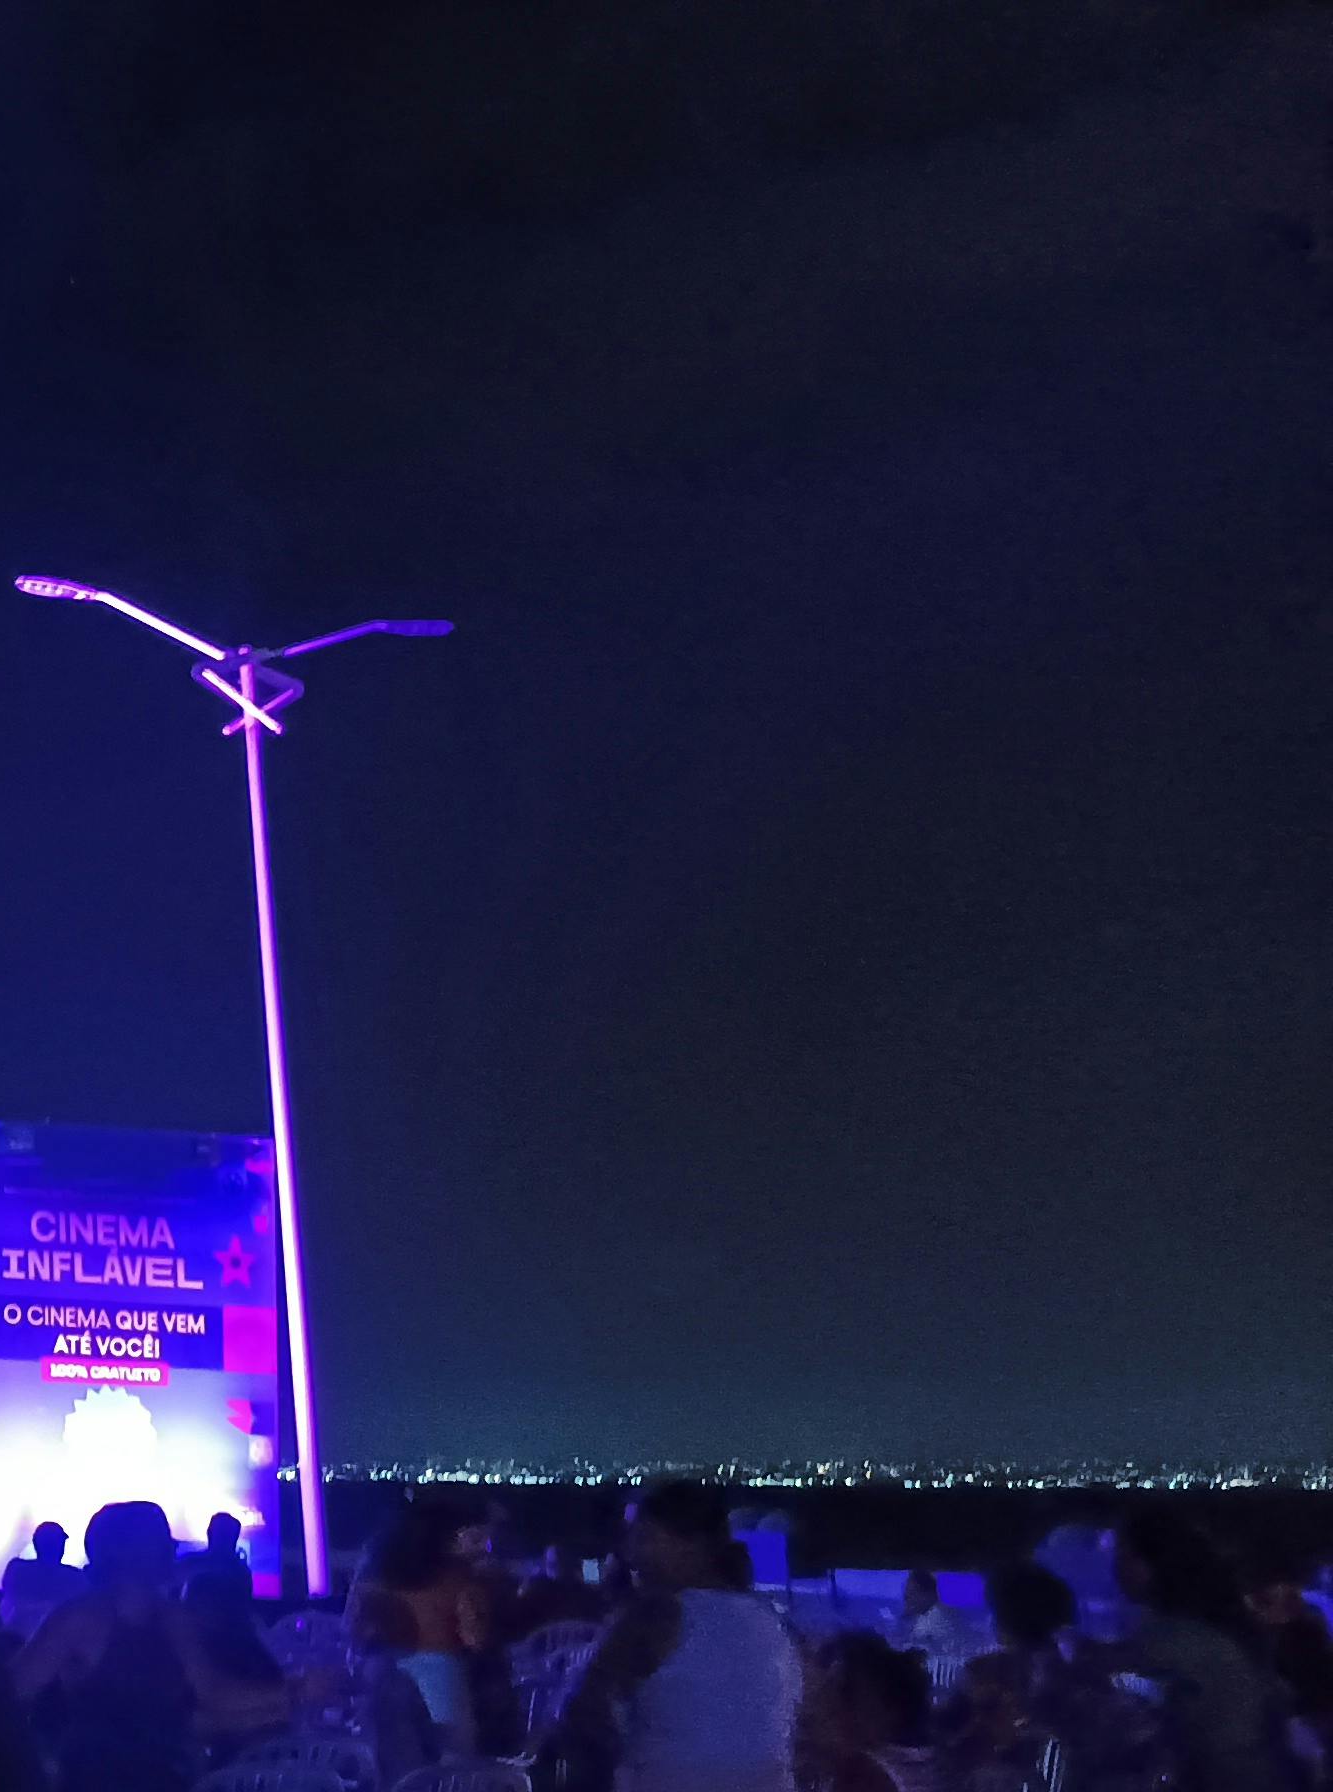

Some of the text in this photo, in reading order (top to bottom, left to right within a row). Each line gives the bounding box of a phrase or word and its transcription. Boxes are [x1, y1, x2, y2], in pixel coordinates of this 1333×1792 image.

[30, 1210, 175, 1249] CINEMA
[1, 1245, 204, 1290] INFLÁVEL
[3, 1303, 206, 1335] O CINEMA QUE VEM
[53, 1330, 92, 1356] ATÉ
